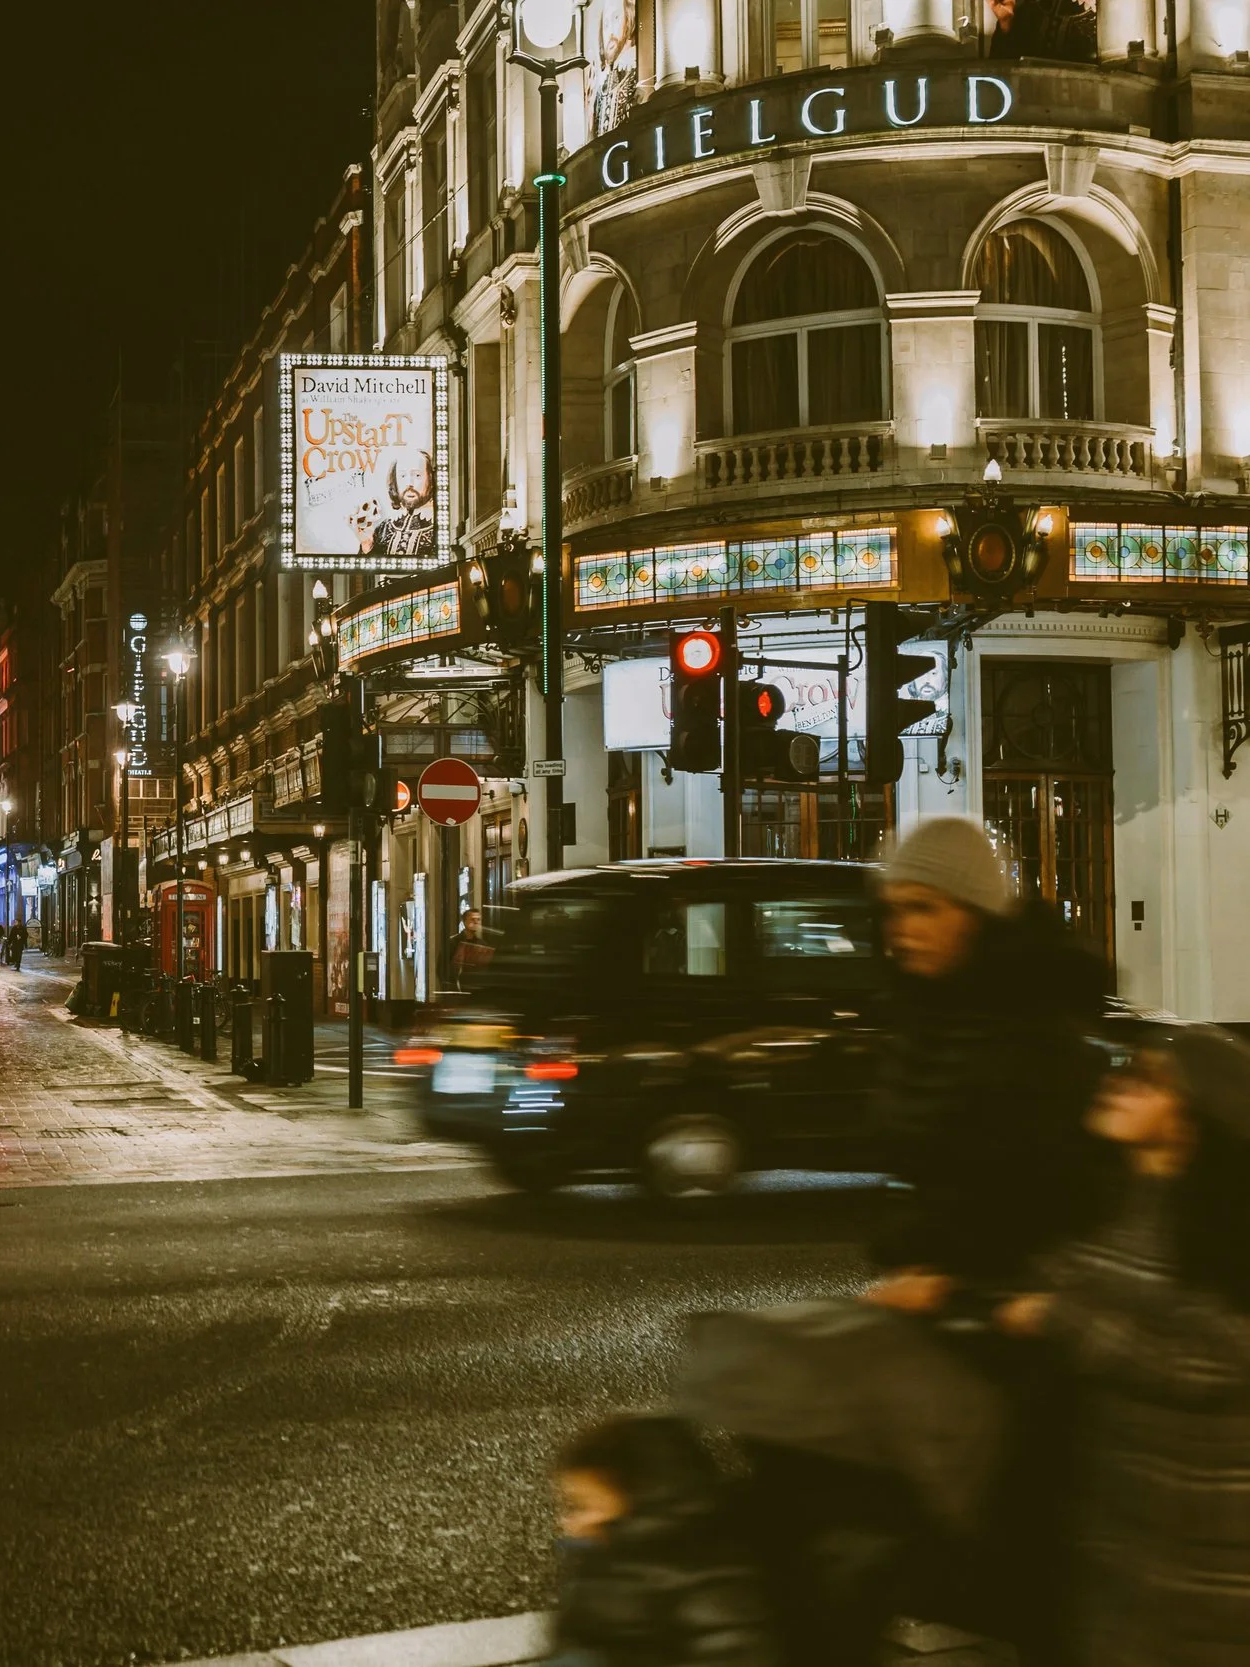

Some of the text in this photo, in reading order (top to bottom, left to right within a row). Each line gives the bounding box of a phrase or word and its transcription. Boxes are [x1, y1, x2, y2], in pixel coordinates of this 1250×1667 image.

[602, 76, 1013, 189] GIELGUD
[301, 376, 427, 394] David Mitchell
[342, 413, 358, 422] The
